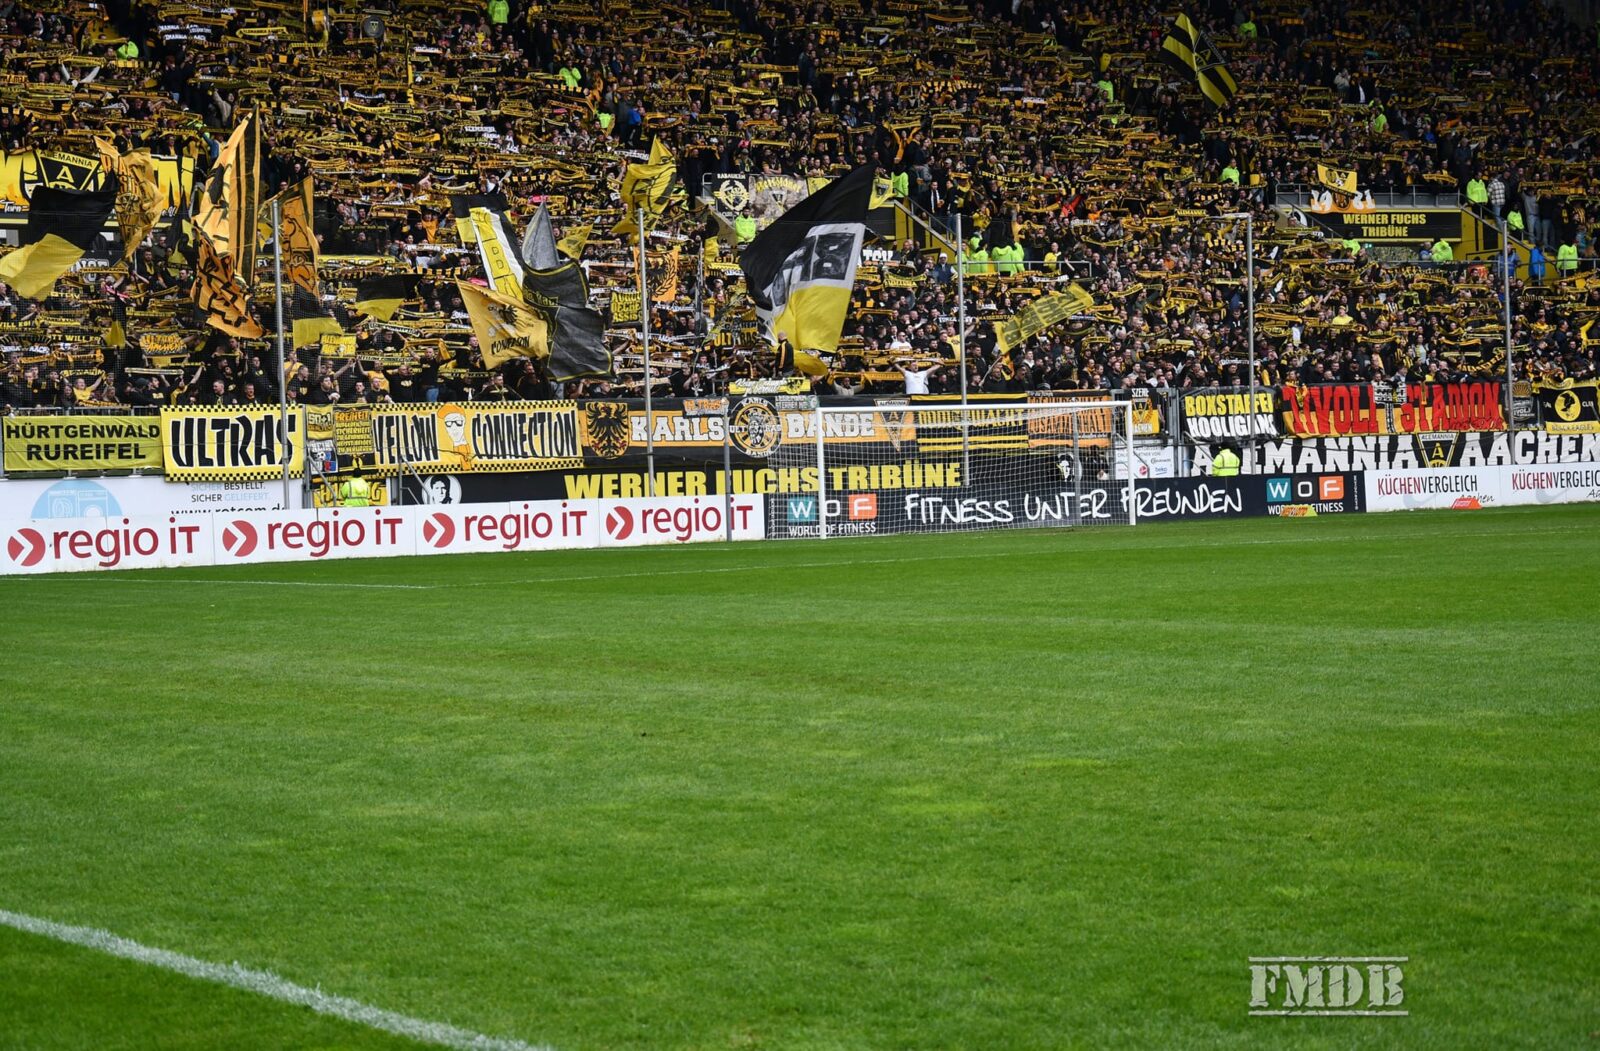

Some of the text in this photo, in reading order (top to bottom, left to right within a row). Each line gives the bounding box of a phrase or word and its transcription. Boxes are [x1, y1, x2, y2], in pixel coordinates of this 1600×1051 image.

[39, 149, 93, 168] AEMANNIA
[1343, 213, 1426, 224] WERNER FUCHS
[1361, 225, 1408, 237] TRIBÜNE
[335, 411, 369, 421] FREIHEIT
[631, 411, 875, 441] KARLS BANDE
[6, 424, 160, 439] HÜRTGENWALD
[171, 414, 297, 468] ULTRAS
[372, 410, 577, 465] YELLOW CONNECTION
[1421, 432, 1455, 441] ALEMANNIA
[27, 443, 146, 460] RUREIFEL
[1191, 430, 1600, 477] AEMANNIA AACHEN
[224, 481, 266, 490] BESTELLT.
[564, 471, 706, 499] WERNER
[829, 459, 961, 491] TRIBÜNE
[1377, 474, 1478, 496] KÜCHENVERGLEICH
[191, 493, 222, 502] SICHER
[904, 482, 1243, 524] FITNESS UNTER FREUNDEN
[1312, 502, 1344, 514] FITNESS
[464, 501, 588, 549] regio iT
[642, 498, 722, 542] regio
[788, 525, 820, 537] WORLD
[838, 521, 877, 534] FITNESS
[53, 517, 200, 567] regio iT
[267, 508, 403, 557] regio iT
